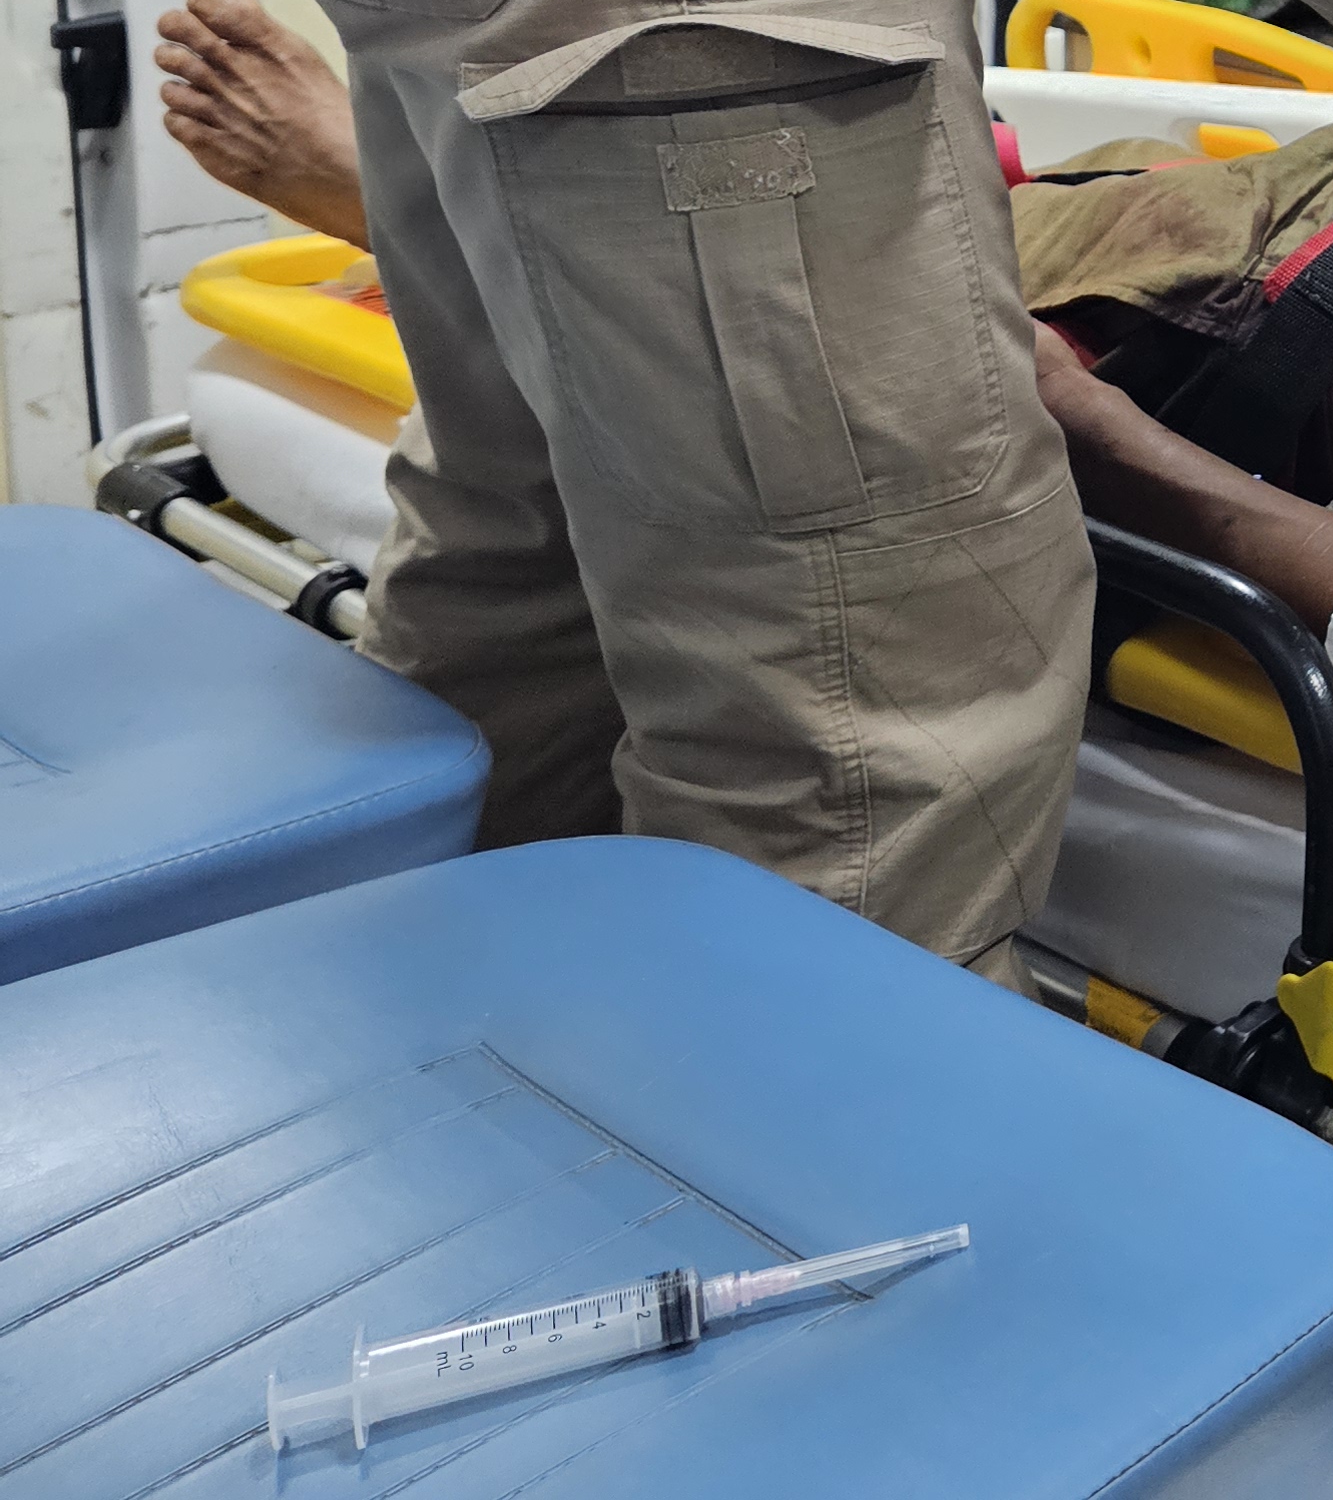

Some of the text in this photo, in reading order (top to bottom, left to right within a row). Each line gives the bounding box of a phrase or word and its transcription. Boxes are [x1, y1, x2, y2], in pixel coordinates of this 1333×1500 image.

[637, 1310, 651, 1321] 2
[592, 1321, 607, 1330] 4
[547, 1333, 563, 1343] 6
[502, 1344, 517, 1354] 8
[436, 1351, 452, 1377] mL
[458, 1353, 475, 1371] 10
